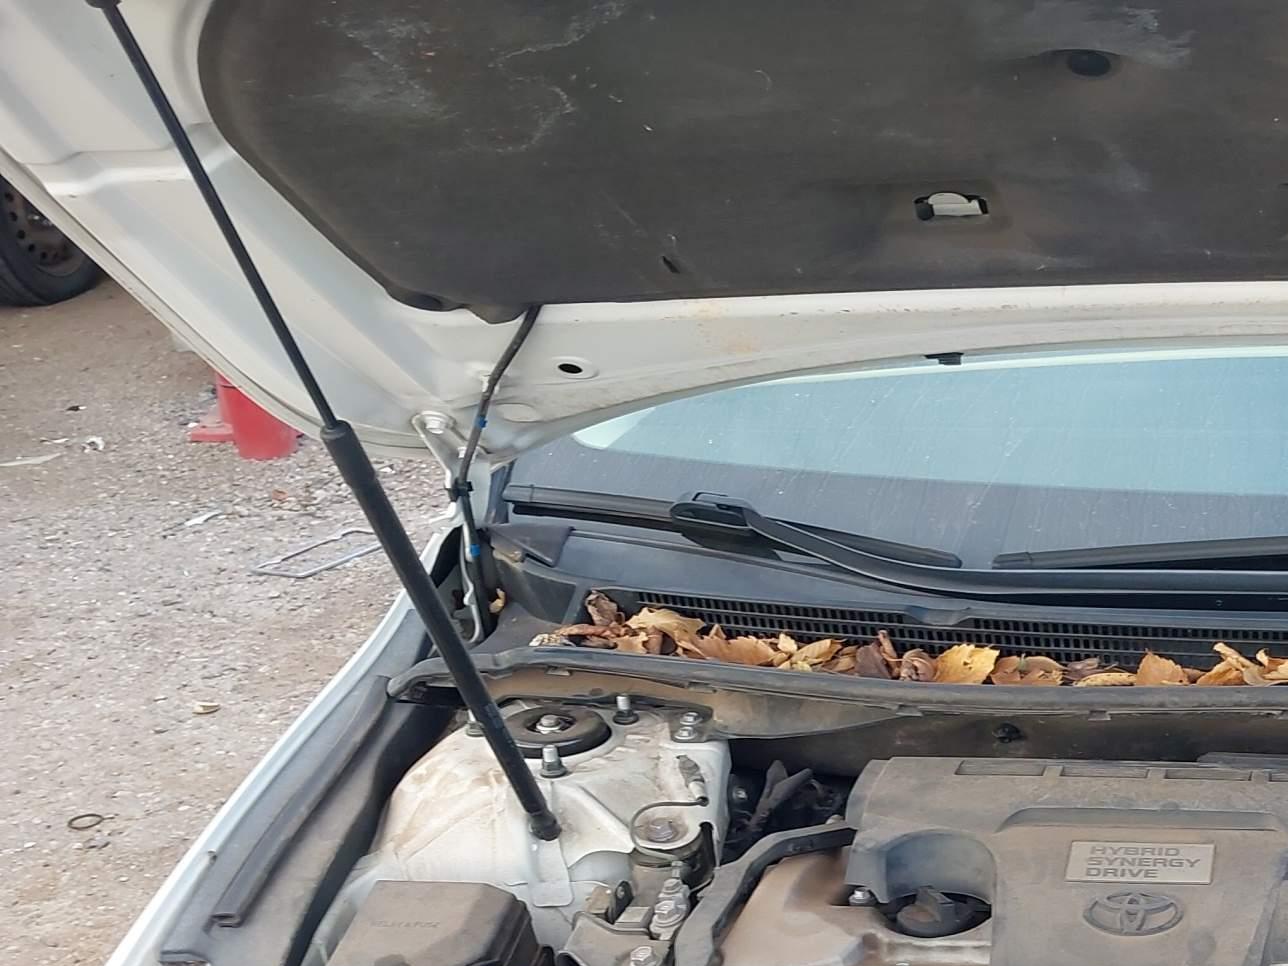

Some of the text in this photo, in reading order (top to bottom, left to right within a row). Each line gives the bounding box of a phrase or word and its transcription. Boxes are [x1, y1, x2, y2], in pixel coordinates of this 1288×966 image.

[1090, 846, 1180, 856] HYBRID
[1087, 856, 1201, 867] SYNERGY
[1085, 867, 1159, 878] DRIVE
